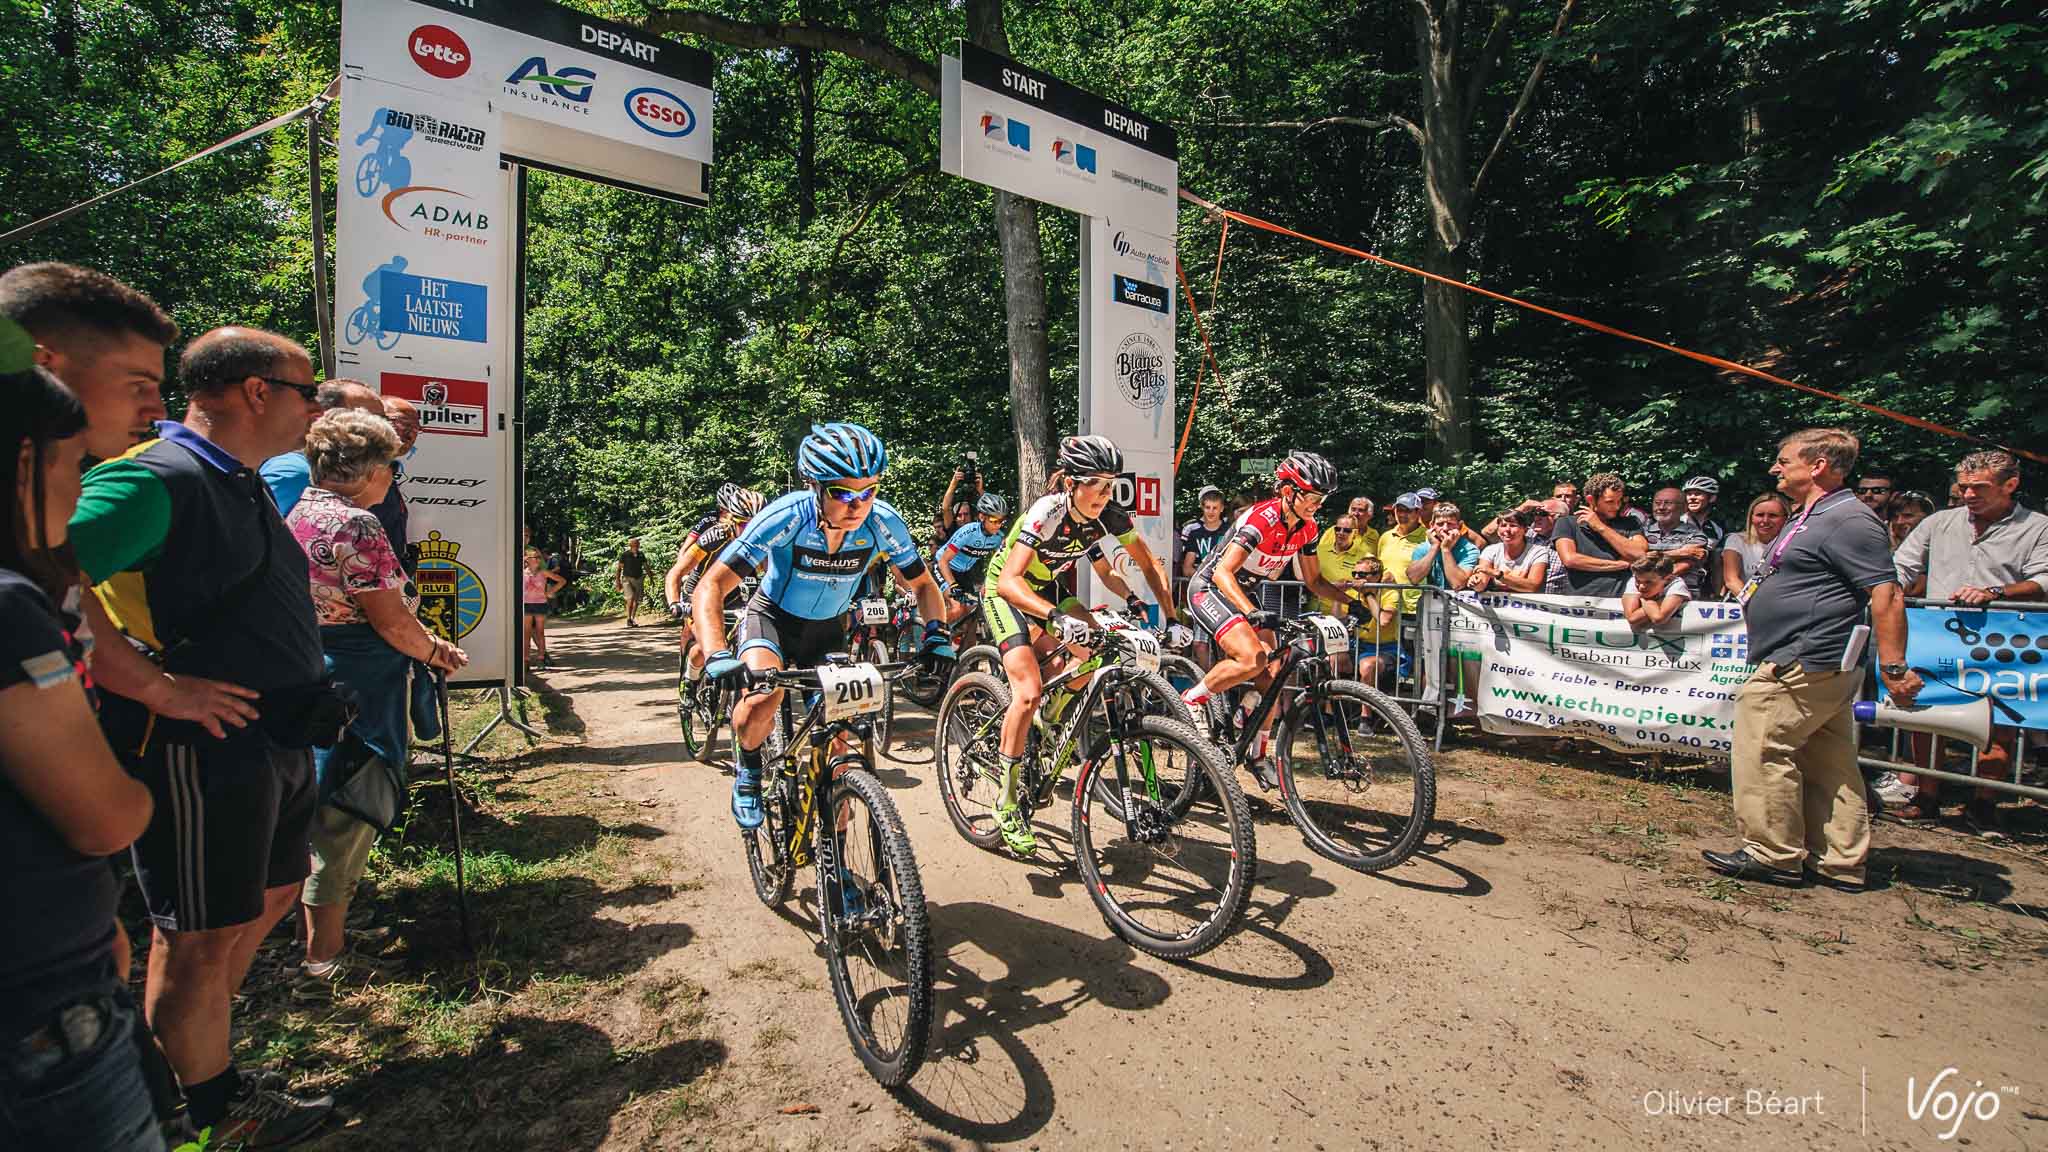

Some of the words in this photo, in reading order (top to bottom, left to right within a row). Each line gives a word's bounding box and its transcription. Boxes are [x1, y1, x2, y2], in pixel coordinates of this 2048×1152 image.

[581, 24, 659, 63] DEPART
[505, 56, 596, 103] AG
[1002, 68, 1047, 100] START
[503, 86, 590, 115] INSURANCE
[438, 121, 486, 146] RACER
[1104, 109, 1150, 142] DEPART
[425, 135, 482, 152] speedwear
[410, 203, 489, 230] ADMB
[424, 227, 487, 246] HR-partner
[421, 279, 448, 299] HET
[1125, 288, 1162, 307] barracuda
[405, 294, 464, 319] LAATSTE
[408, 314, 460, 337] NIEUWS
[1117, 352, 1163, 376] Blancs
[408, 476, 488, 488] RIDLEY
[408, 497, 487, 508] RIDLEY
[422, 584, 450, 593] RLVB
[866, 607, 885, 616] 206
[1324, 626, 1345, 640] 204
[1560, 647, 1632, 665] Brabant
[1644, 655, 1702, 672] Belux
[835, 677, 874, 705] 201
[1490, 663, 1535, 677] Rapide
[1551, 672, 1598, 687] Fiable
[1615, 680, 1669, 695] Propre
[1505, 708, 1541, 721] 0477
[1548, 714, 1566, 727] 84
[1636, 729, 1670, 743] 010
[1679, 735, 1702, 748] 40
[1709, 739, 1732, 752] 29
